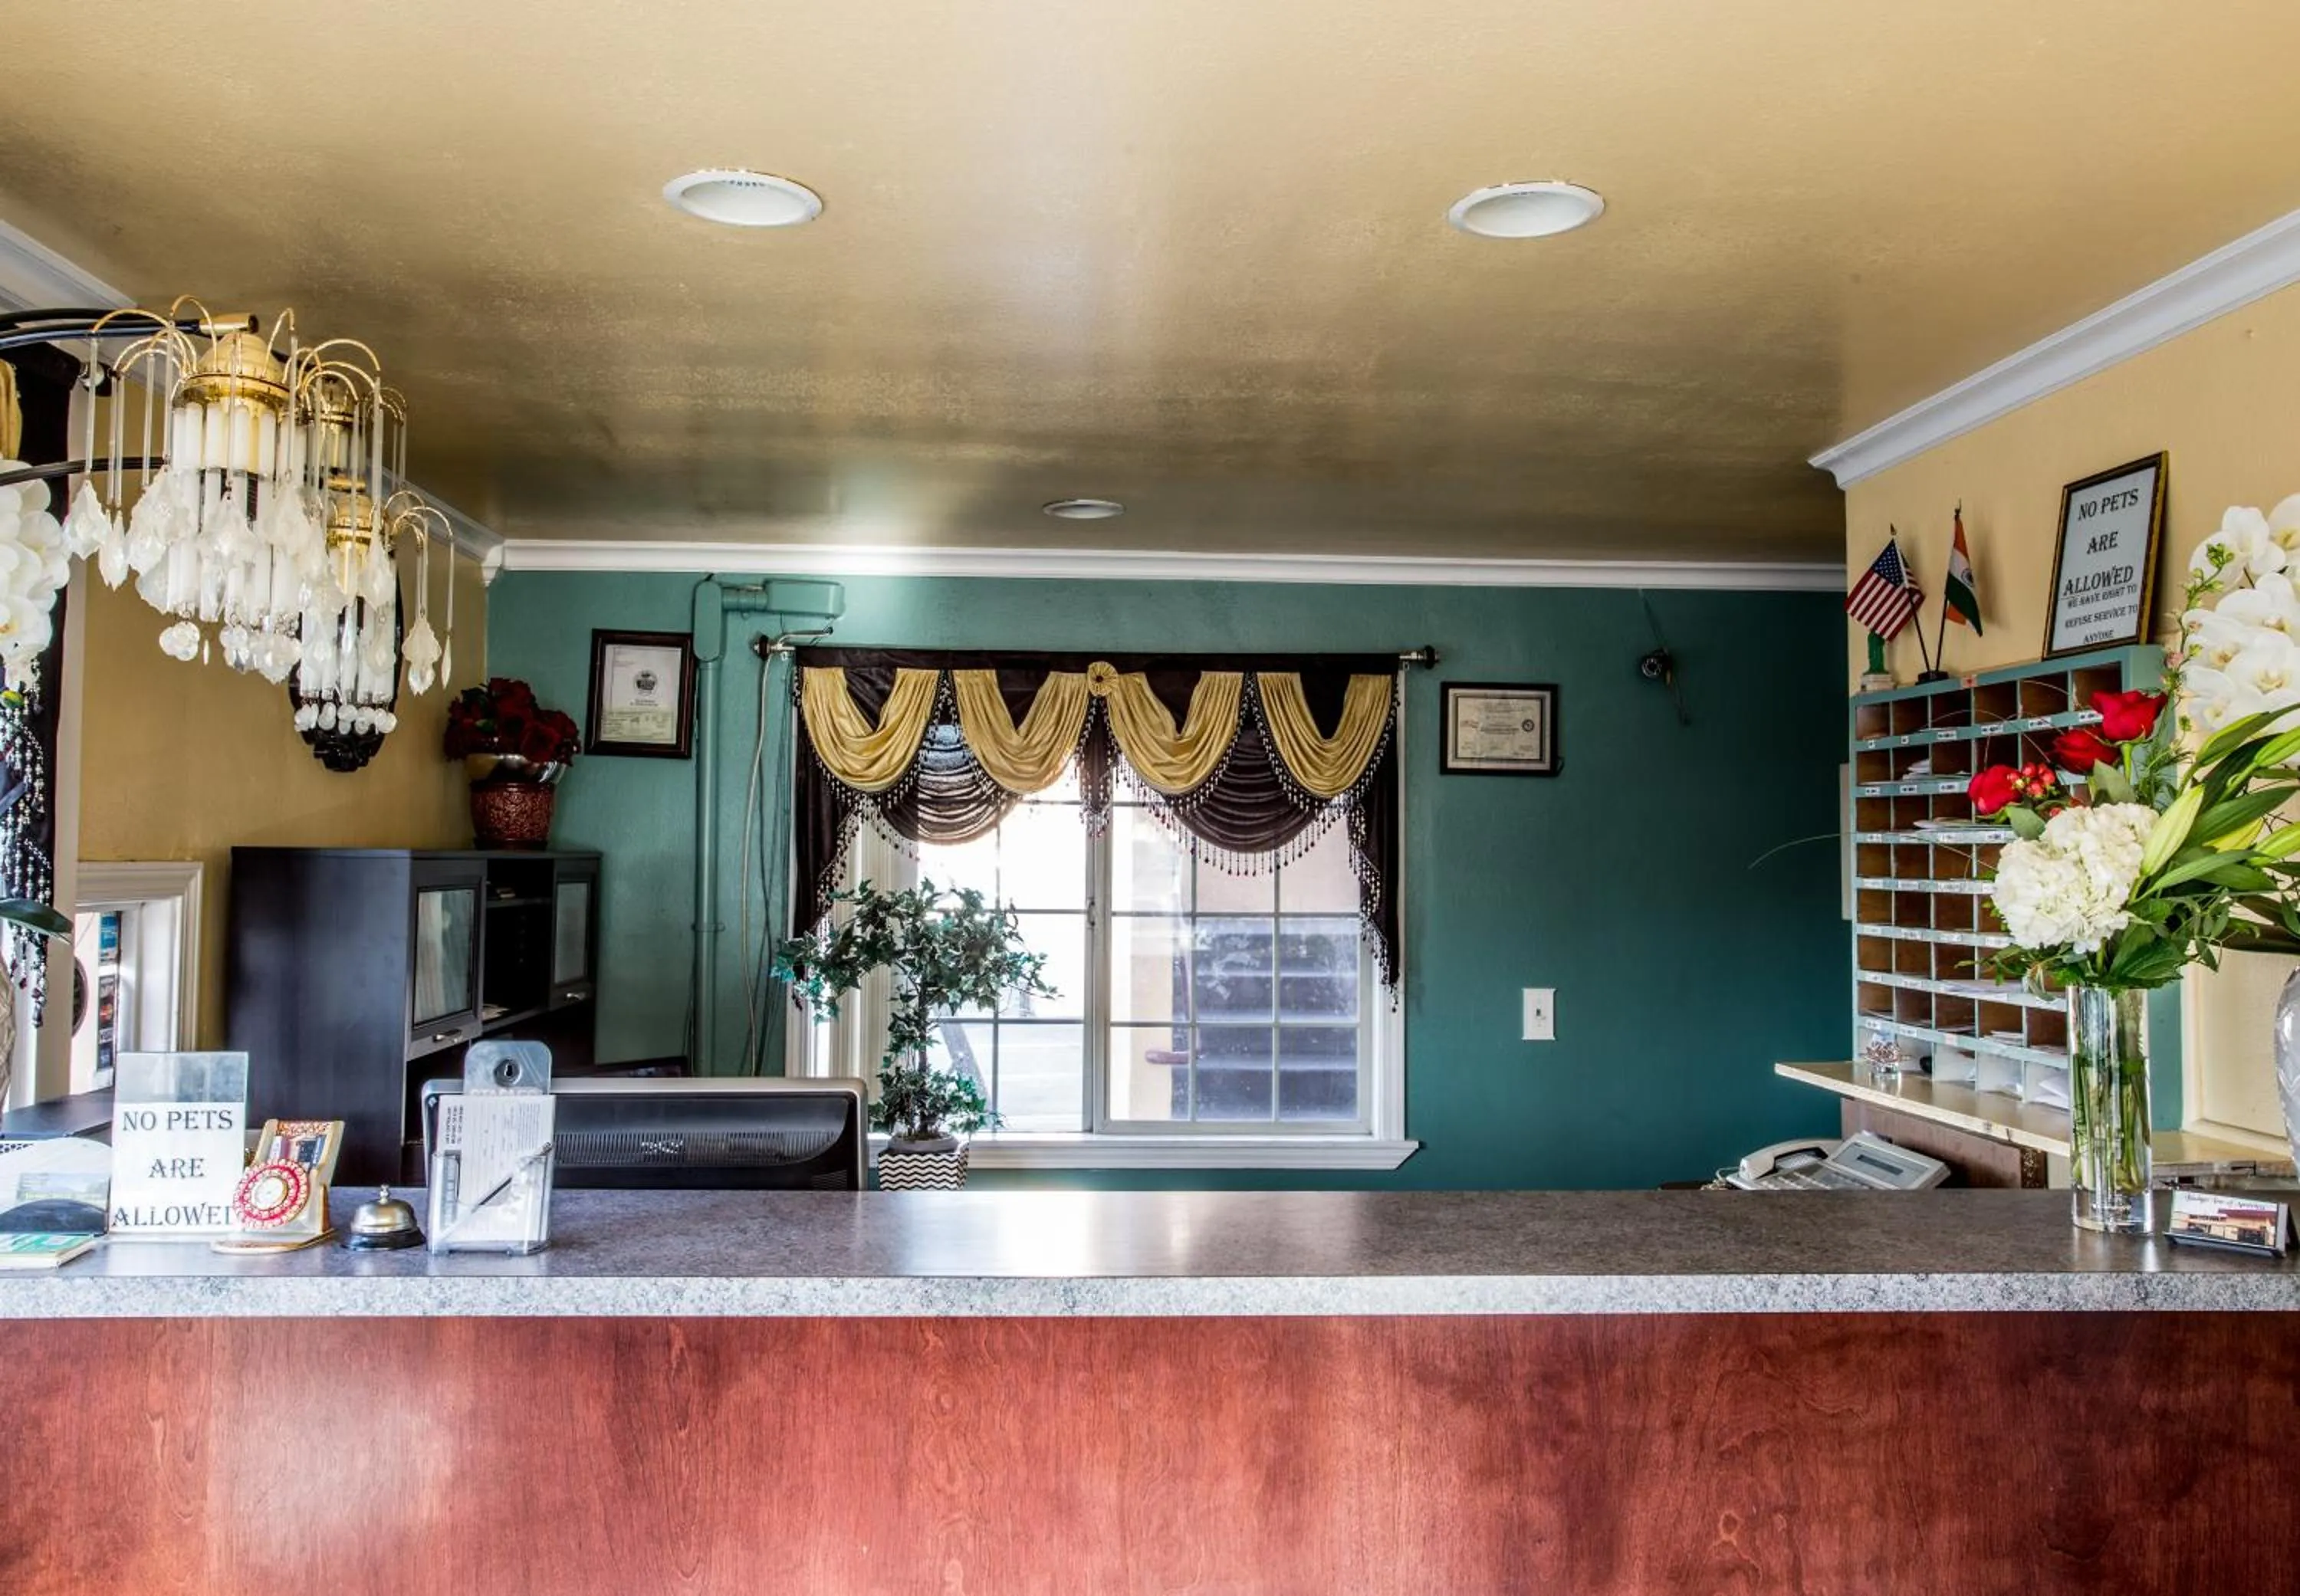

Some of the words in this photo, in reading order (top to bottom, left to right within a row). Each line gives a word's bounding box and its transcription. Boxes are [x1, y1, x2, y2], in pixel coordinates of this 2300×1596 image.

[2078, 501, 2097, 521] NO
[2101, 488, 2139, 514] PETS
[2086, 531, 2119, 554] ARE
[2063, 564, 2134, 596] ALLOWED
[2079, 592, 2101, 606] HAVE
[2127, 583, 2137, 593] TO
[2065, 614, 2092, 628] REFUSE
[2093, 606, 2126, 622] SERVICE
[2128, 603, 2138, 616] TO
[123, 1111, 156, 1131] NO
[167, 1109, 233, 1131] PETS
[149, 1158, 205, 1179] ARE
